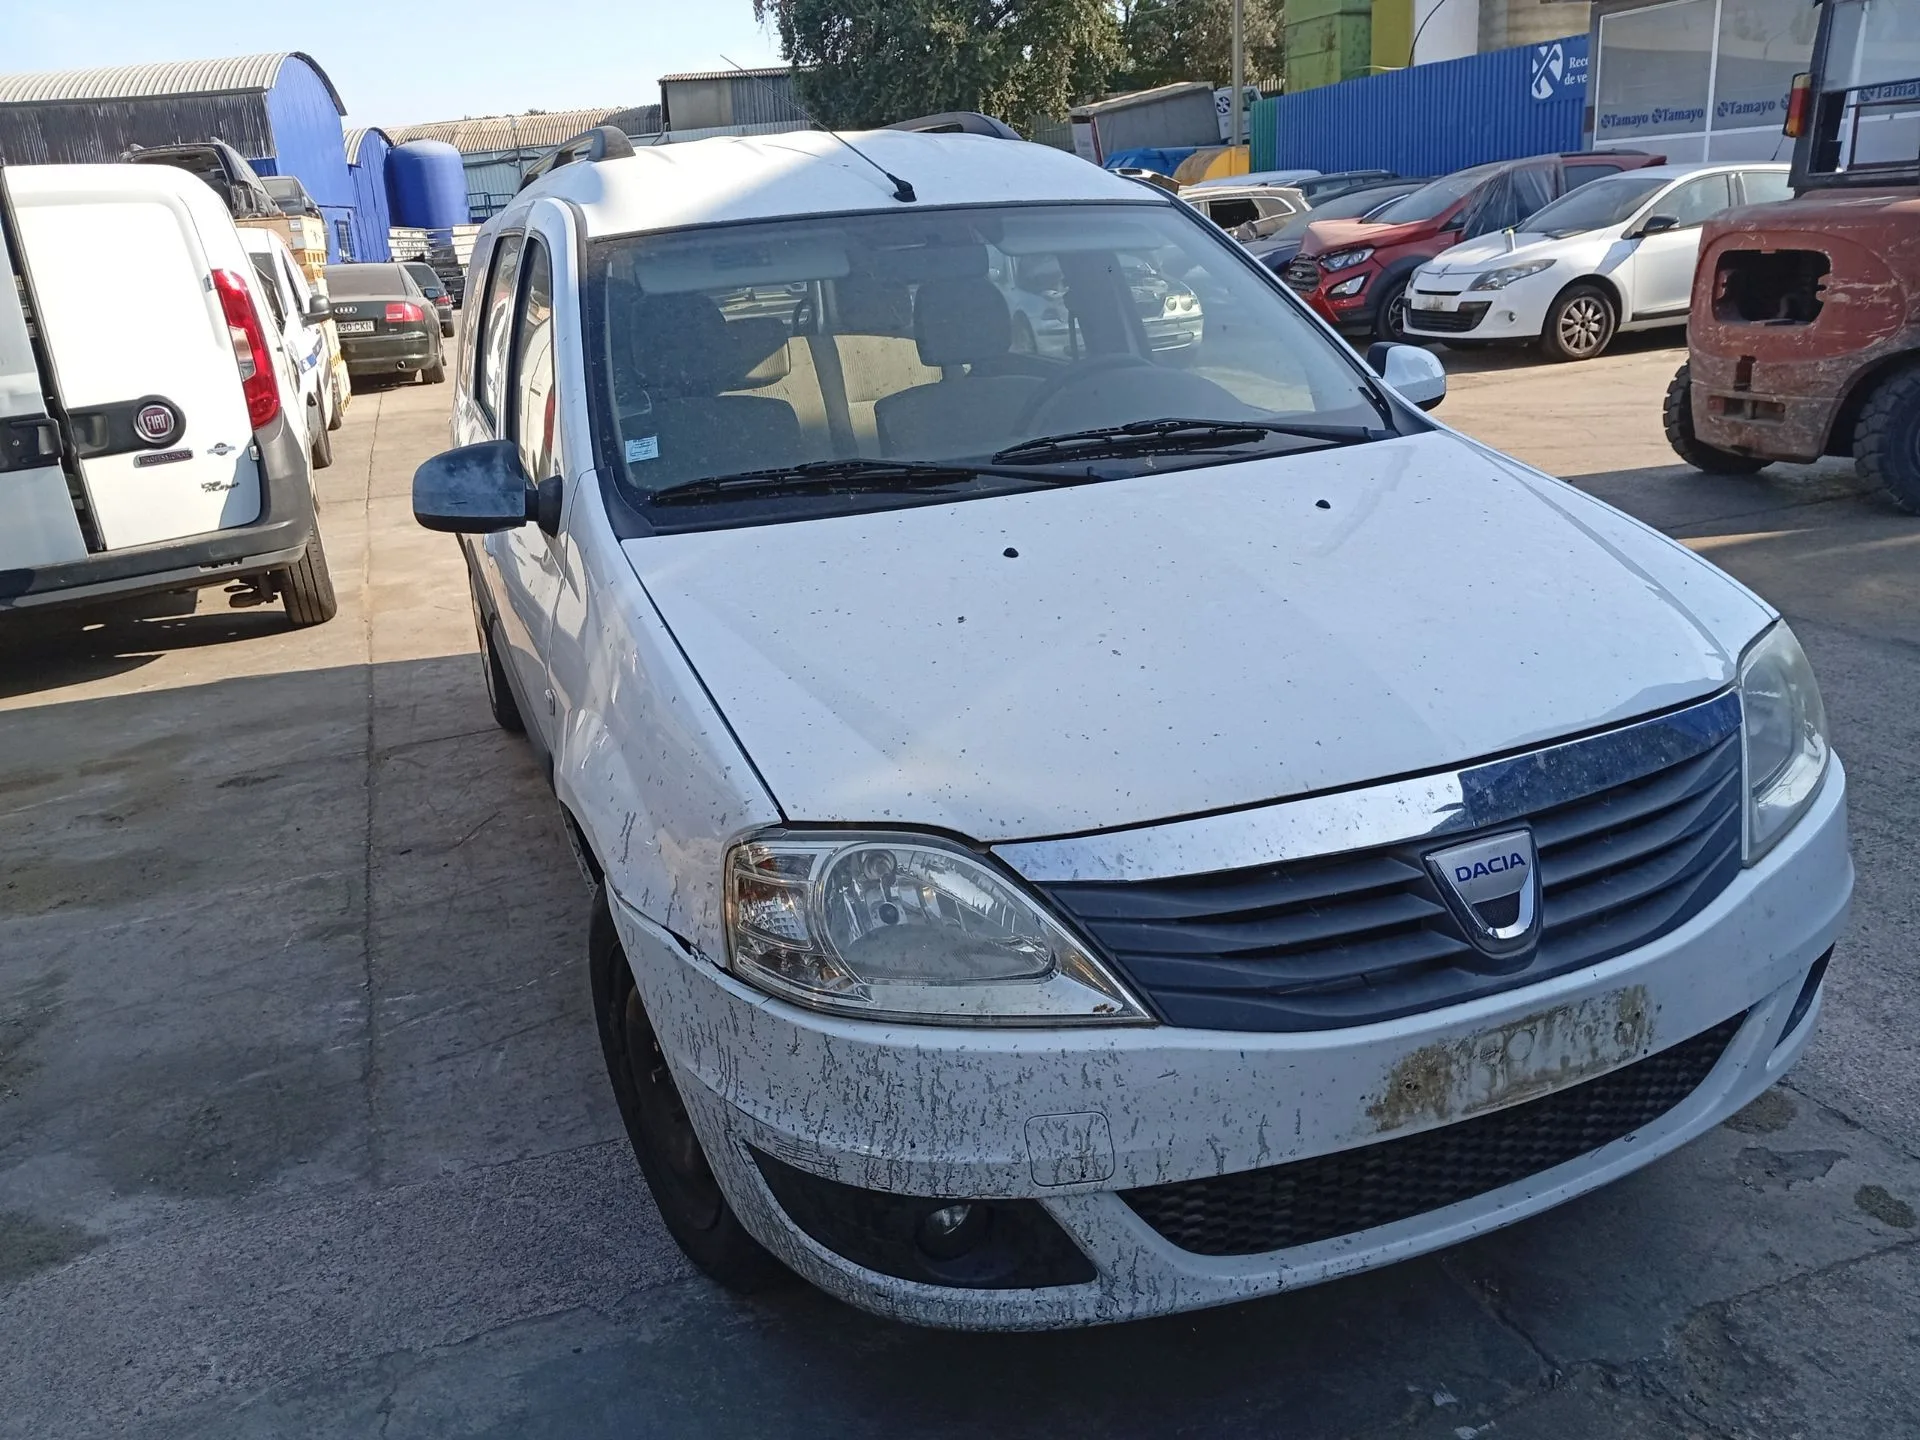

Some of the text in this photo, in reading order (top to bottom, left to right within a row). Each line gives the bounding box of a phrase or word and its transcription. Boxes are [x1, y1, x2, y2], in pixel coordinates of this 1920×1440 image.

[1564, 72, 1576, 85] de
[1873, 84, 1920, 98] Tama
[1611, 100, 1776, 128] Tamayo Tamayo Tamayo
[146, 413, 166, 430] FIAT
[1455, 852, 1526, 882] DACIA
